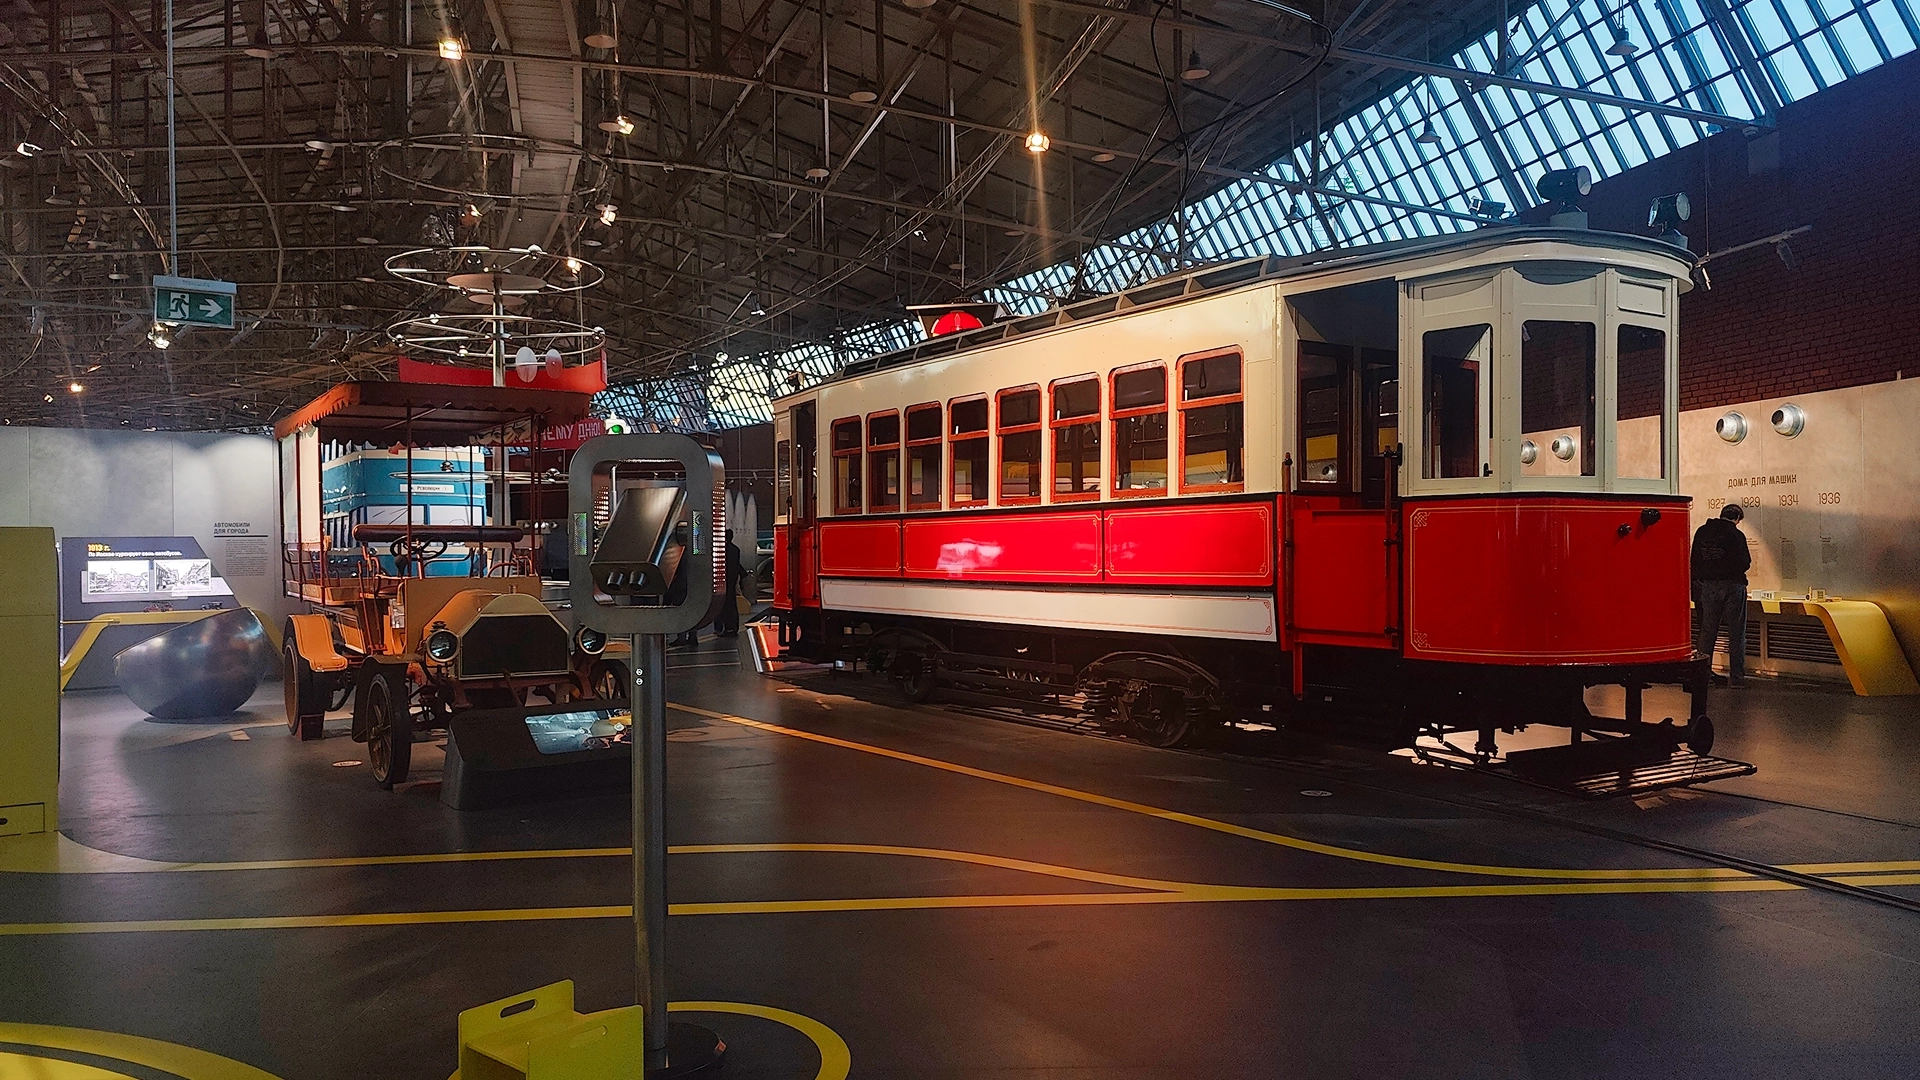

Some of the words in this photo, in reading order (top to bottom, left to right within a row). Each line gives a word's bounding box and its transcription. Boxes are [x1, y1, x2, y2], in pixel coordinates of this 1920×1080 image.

[1728, 478, 1749, 489] ДОМА
[1750, 477, 1766, 487] ДЛЯ
[1768, 474, 1797, 485] МАШИН
[1707, 498, 1726, 509] 1927
[1740, 496, 1761, 508] 1929
[1778, 494, 1799, 507] 1934
[1818, 492, 1841, 505] 1936
